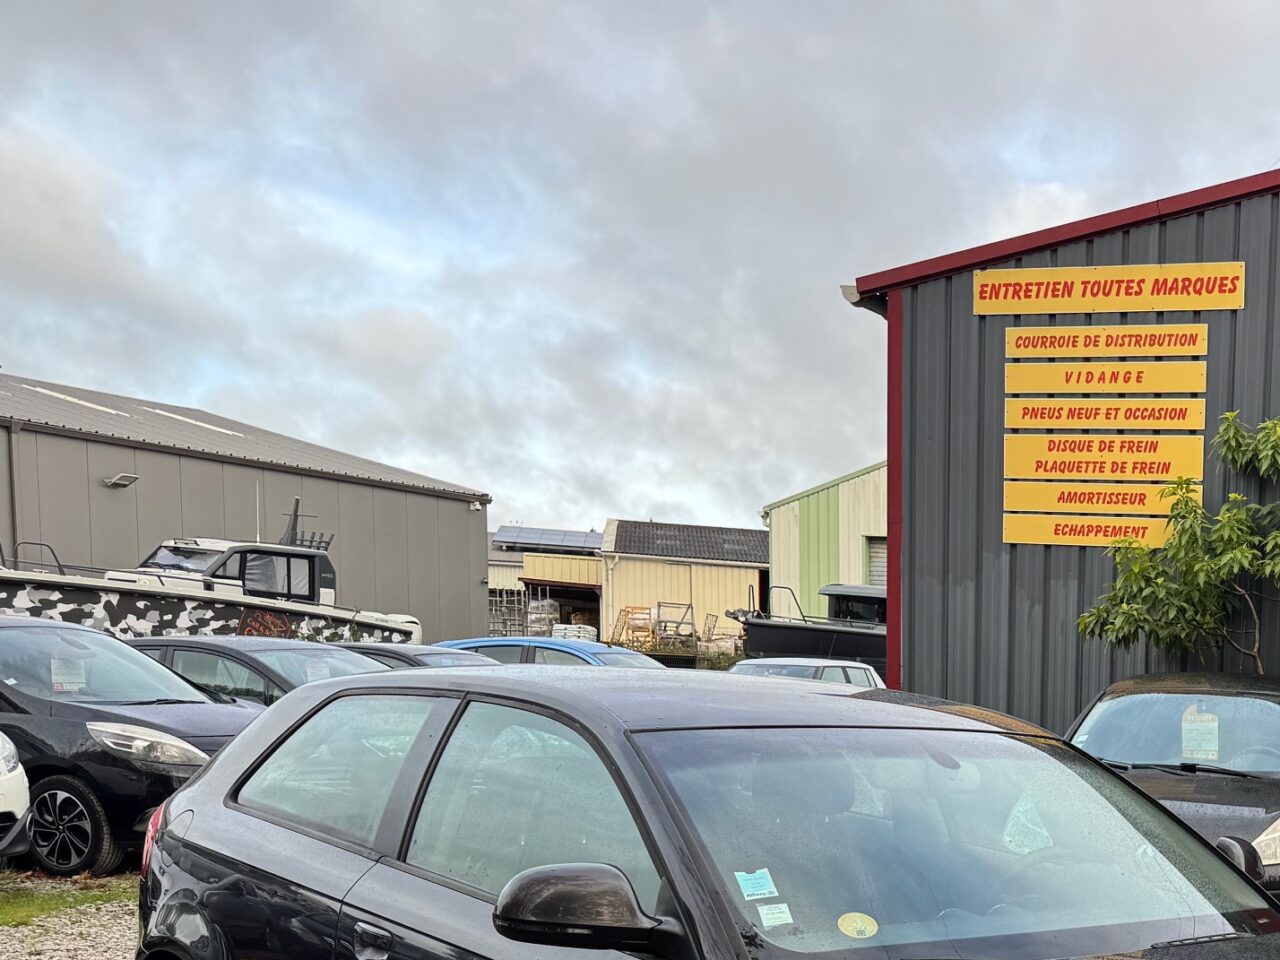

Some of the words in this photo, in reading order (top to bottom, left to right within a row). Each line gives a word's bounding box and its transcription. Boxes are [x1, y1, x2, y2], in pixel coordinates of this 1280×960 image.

[978, 280, 1074, 301] ENTRETIEN
[1080, 278, 1146, 298] TOUTES
[1150, 275, 1240, 298] MARQUES
[1015, 335, 1079, 349] COURROIE
[1083, 335, 1101, 348] DE
[1104, 333, 1198, 348] DISTRIBUTION
[1065, 370, 1145, 384] VIDANGE
[1021, 407, 1064, 420] PNEUS
[1067, 407, 1101, 420] NEUF
[1105, 407, 1121, 420] ET
[1124, 407, 1188, 421] OCCASION
[1047, 439, 1094, 454] DISQUE
[1098, 440, 1115, 453] DE
[1119, 440, 1158, 454] FREIN
[1034, 460, 1106, 474] PLAQUETTE
[1110, 461, 1128, 474] DE
[1131, 461, 1171, 475] FREIN
[1057, 491, 1146, 506] AMORTISSEUR
[1053, 523, 1148, 539] ECHAPPEMENT
